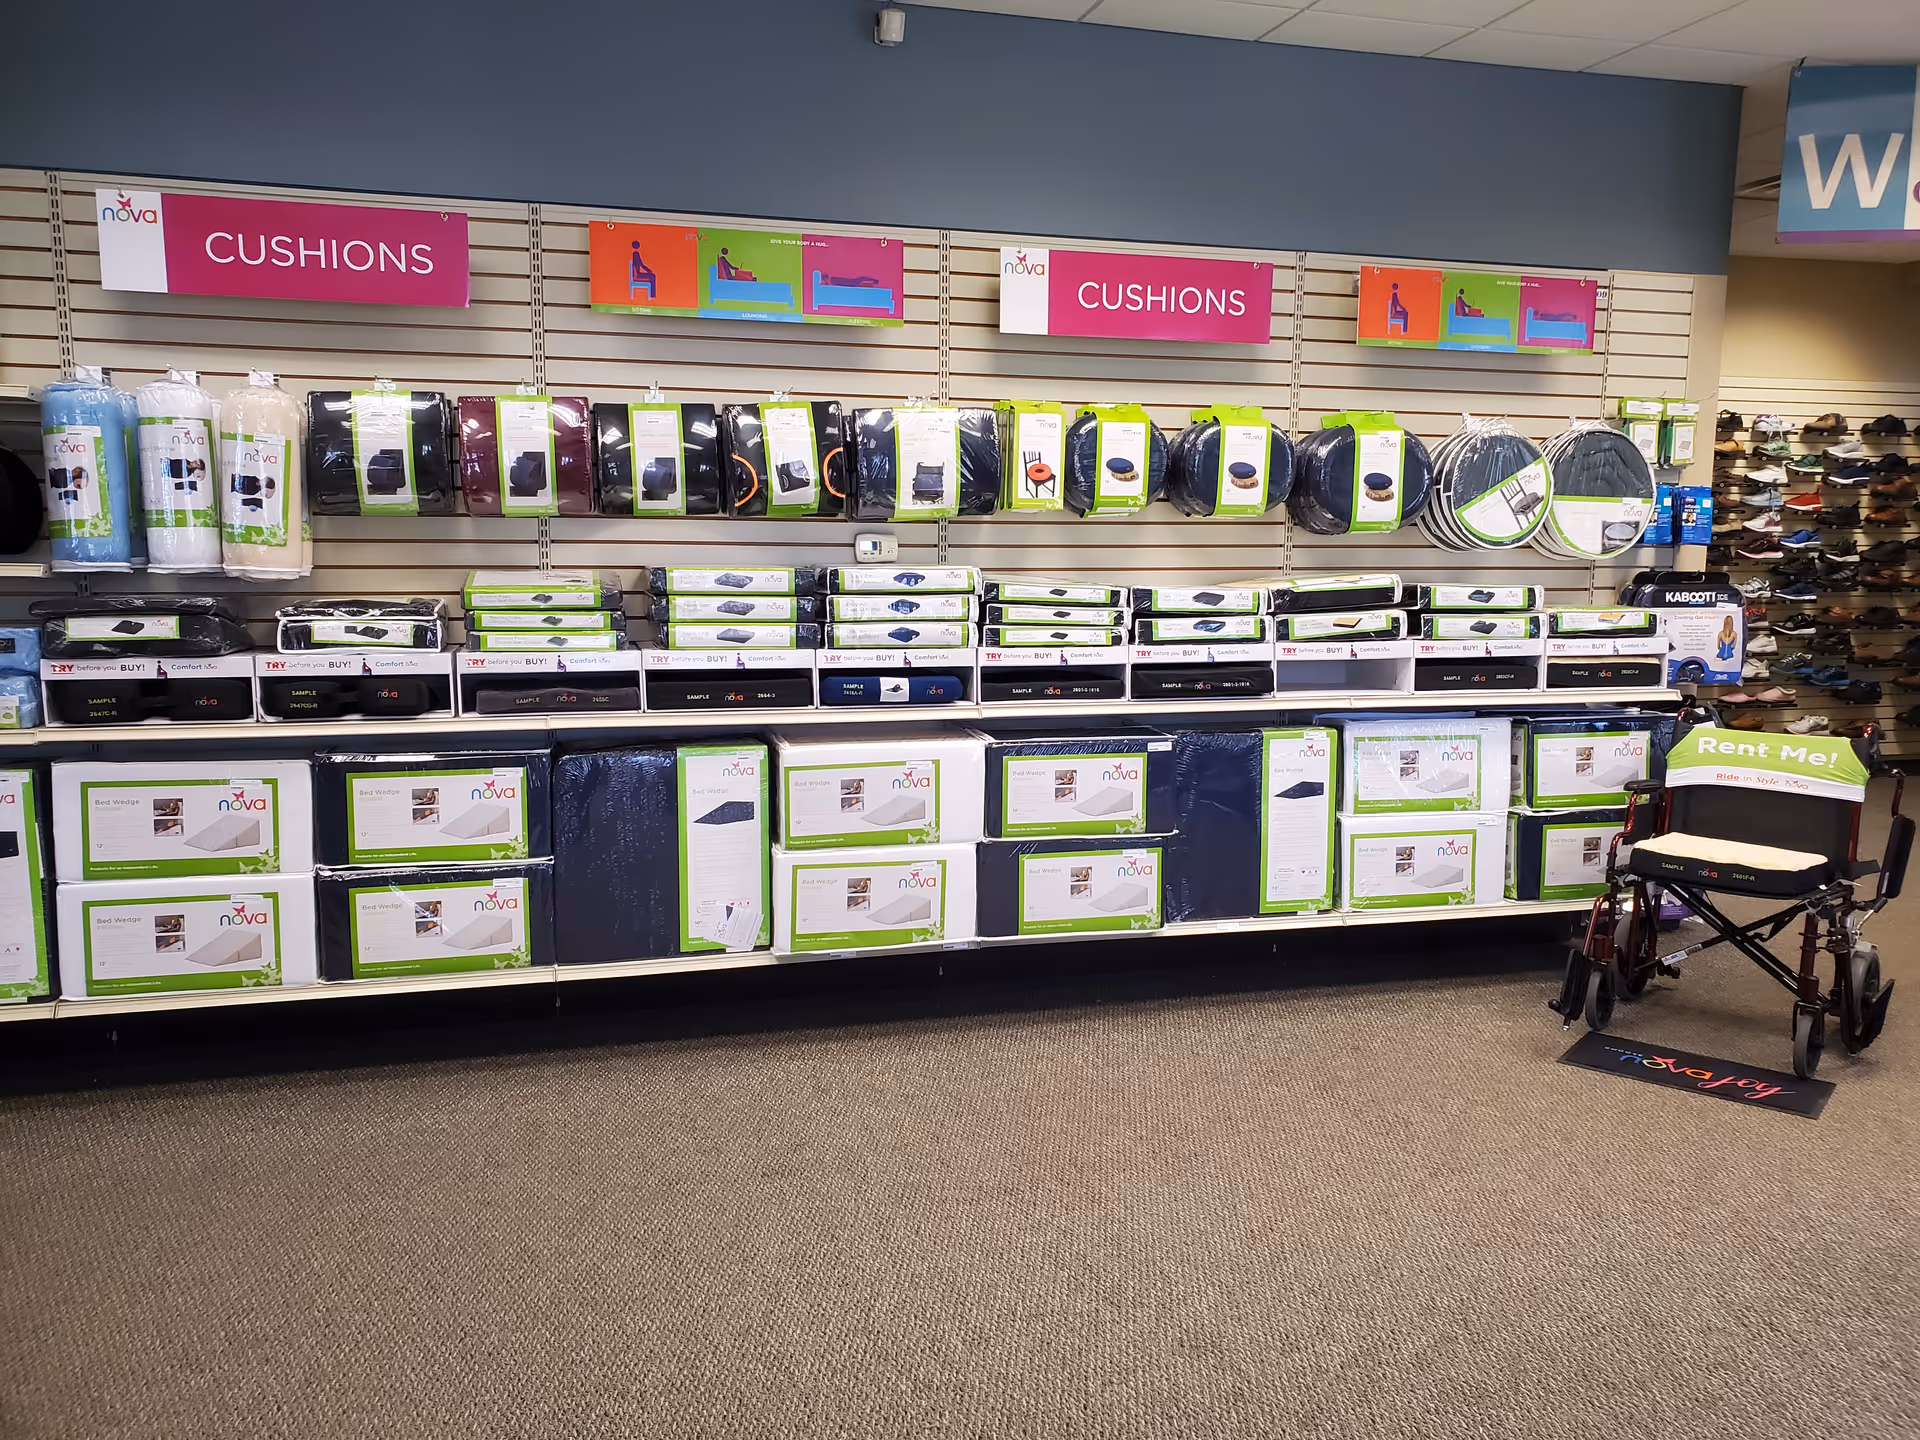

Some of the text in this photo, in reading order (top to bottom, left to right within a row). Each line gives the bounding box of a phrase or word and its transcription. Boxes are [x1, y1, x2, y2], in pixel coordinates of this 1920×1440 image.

[103, 205, 157, 226] nova
[205, 231, 434, 276] CUSHIONS
[1004, 260, 1046, 277] nova
[1077, 280, 1246, 317] CUSHIONS
[172, 434, 205, 446] nova
[54, 443, 86, 455] nova
[244, 451, 277, 466] nova
[1665, 592, 1716, 603] KABOOTI
[465, 658, 486, 666] TRY
[650, 655, 669, 663] TRY
[876, 654, 895, 662] BUY!
[986, 652, 1003, 660] TRY
[50, 664, 74, 673] TRY
[120, 664, 145, 672] BUY!
[265, 661, 287, 669] TRY
[88, 697, 117, 705] SAMPLE
[194, 697, 218, 706] nova
[515, 696, 541, 704] SAMPLE
[1299, 748, 1325, 758] nova
[1442, 750, 1473, 761] nova
[1614, 746, 1642, 757] nova
[1698, 737, 1838, 770] Rent Me!
[723, 765, 755, 777] nova
[1103, 769, 1138, 781] nova
[892, 775, 930, 789] nova
[1716, 772, 1740, 781] Ride
[1755, 775, 1780, 786] Style
[0, 794, 15, 804] va
[375, 789, 400, 797] Wedge
[471, 787, 516, 801] nova
[112, 799, 140, 807] Wedge
[219, 799, 266, 811] nova
[1437, 843, 1468, 856] nova
[1118, 865, 1153, 877] nova
[1661, 862, 1684, 872] SAMPLE
[1698, 868, 1718, 879] nova
[899, 876, 937, 889] nova
[362, 902, 403, 911] Bed Wedge
[474, 897, 518, 911] nova
[114, 917, 142, 926] Wedge
[220, 913, 268, 926] nova
[1620, 1055, 1714, 1080] nova
